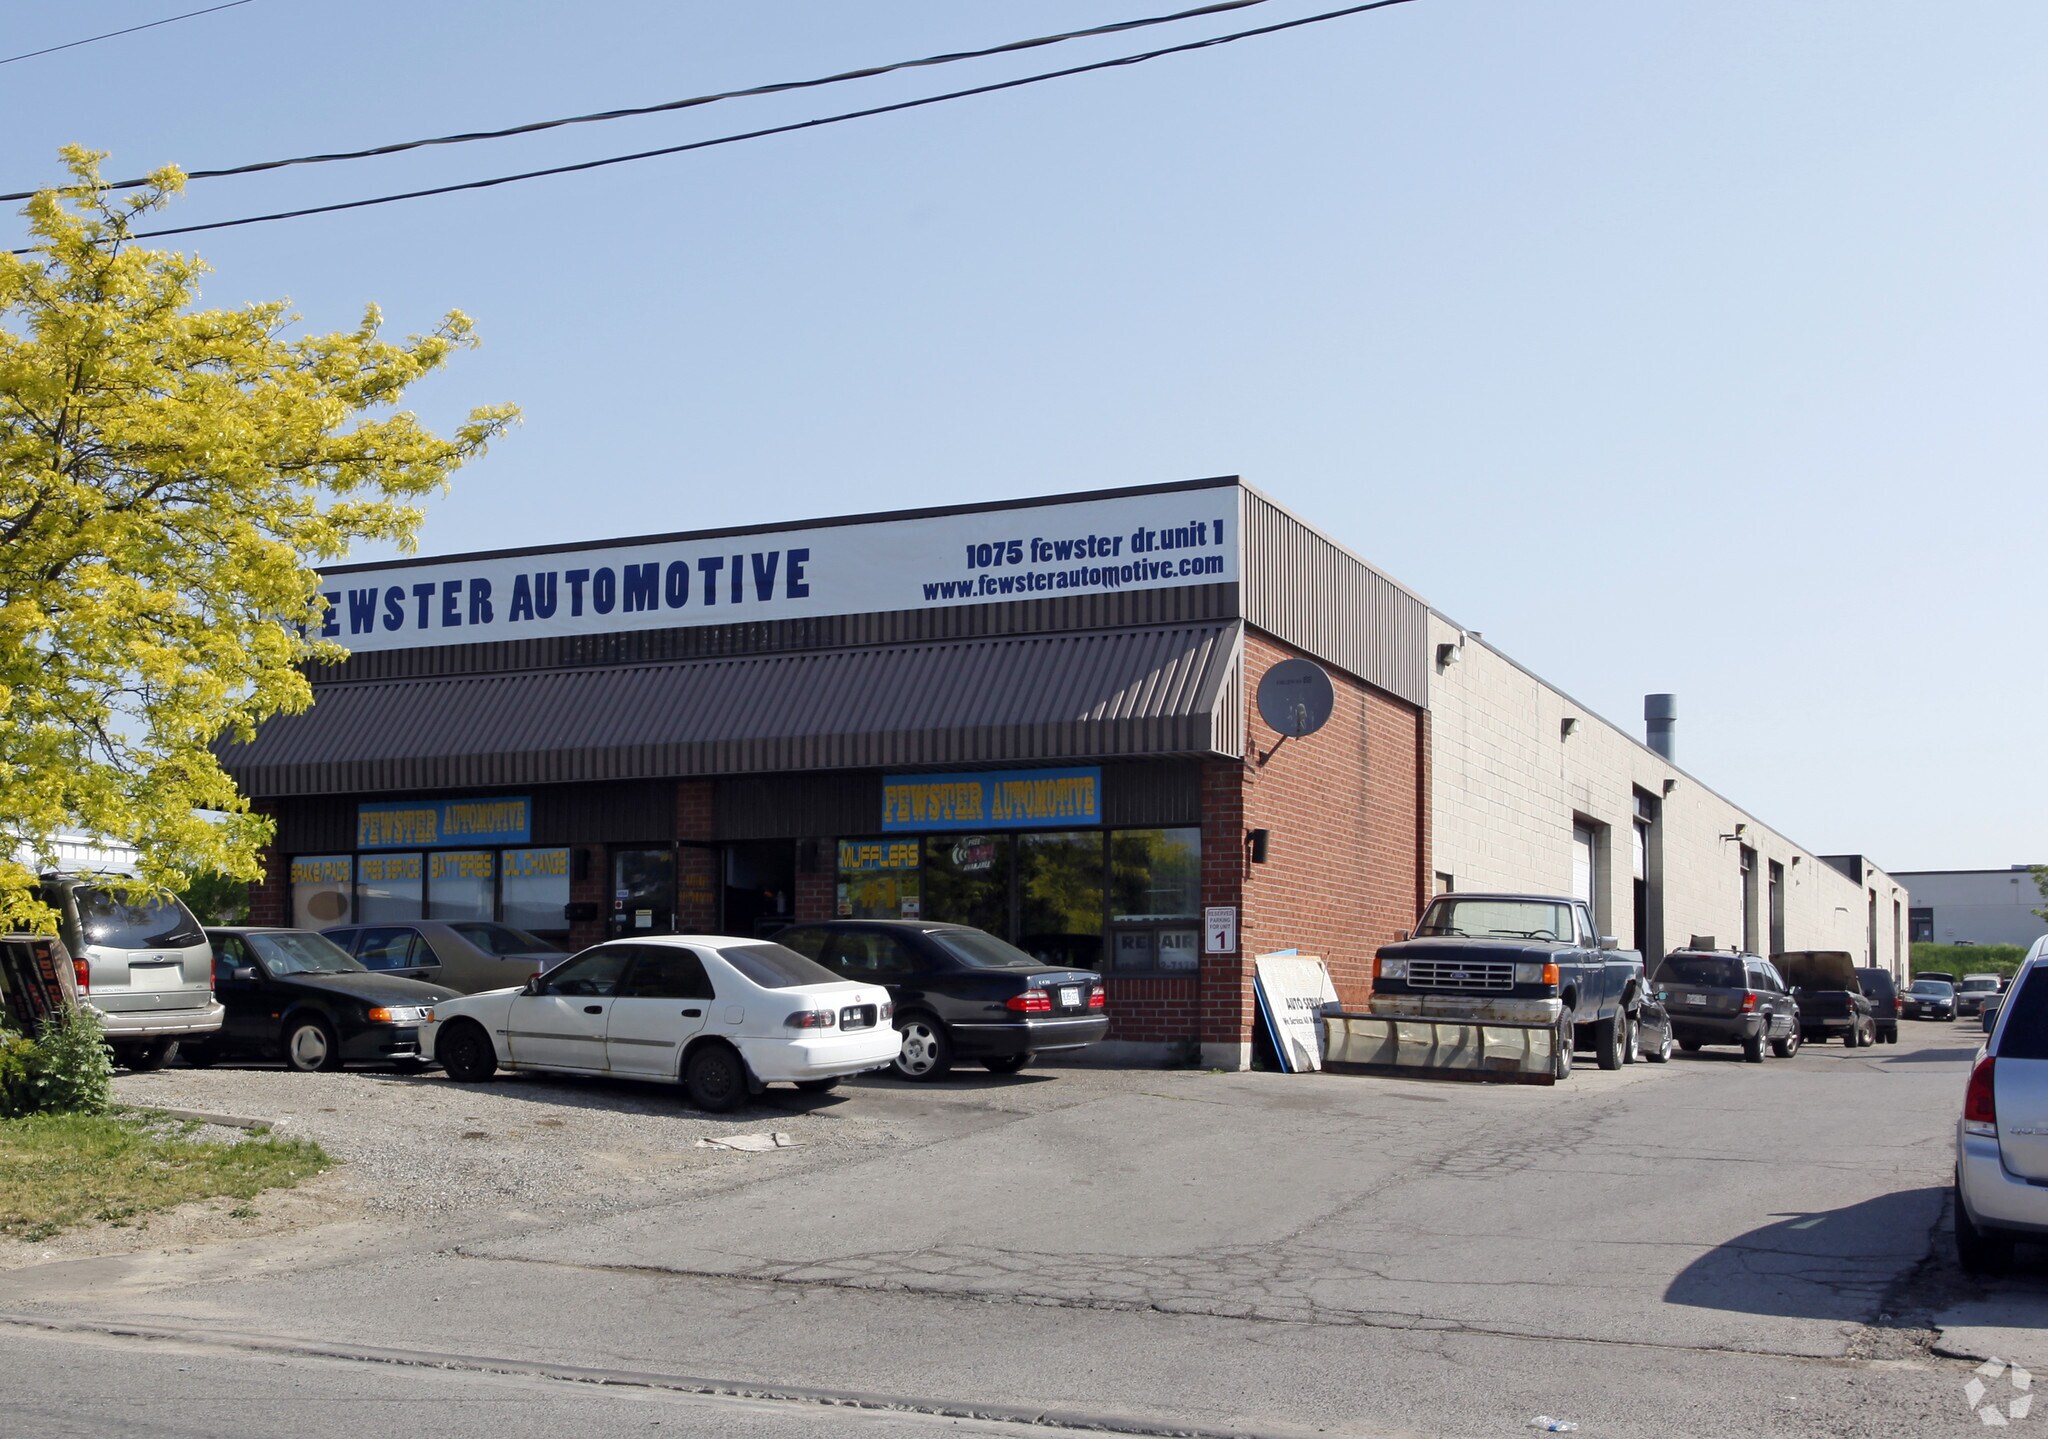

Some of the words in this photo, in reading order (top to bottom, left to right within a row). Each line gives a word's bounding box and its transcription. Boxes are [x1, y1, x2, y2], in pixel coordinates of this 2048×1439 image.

[966, 539, 1023, 569] 1075
[1031, 531, 1122, 563] fewster
[1131, 522, 1208, 552] dr.unit
[1213, 519, 1224, 545] 1
[508, 548, 810, 623] AUTOMOTIVE
[923, 552, 1224, 600] www.fewsterautomotive.com
[884, 782, 983, 824] FEWSTER
[991, 776, 1095, 820] AUTOMOTIVE
[359, 810, 437, 845] FEWSTER
[443, 801, 525, 835] AUTOMOTIVE
[431, 854, 492, 878] BATTERIES
[524, 851, 567, 875] CHANGE
[841, 844, 919, 868] MUFFLERS
[1215, 931, 1225, 950] 1
[1285, 997, 1304, 1010] AUTO
